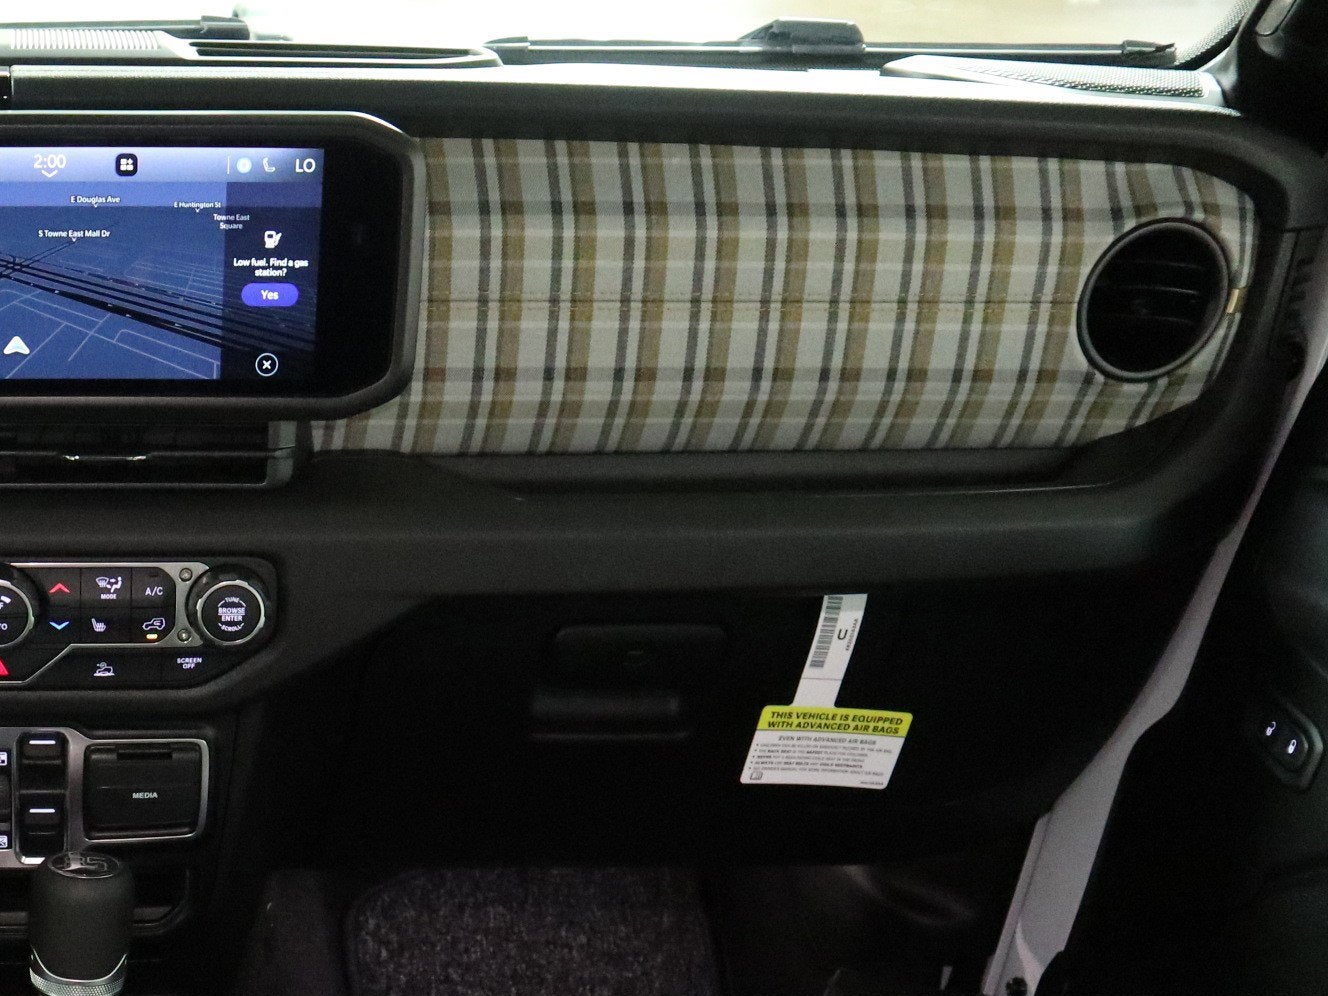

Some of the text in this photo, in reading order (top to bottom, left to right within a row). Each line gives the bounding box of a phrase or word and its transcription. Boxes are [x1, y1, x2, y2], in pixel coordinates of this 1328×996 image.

[33, 154, 66, 169] 2:00
[295, 158, 315, 173] LO
[76, 195, 105, 205] Douglas
[179, 201, 211, 210] Huntington
[219, 222, 243, 231] Square
[44, 230, 67, 238] Towne
[69, 230, 83, 238] East
[85, 230, 100, 238] Mall
[102, 230, 110, 238] Dr
[233, 258, 250, 267] Low
[251, 258, 268, 267] fuel.
[269, 258, 287, 267] Find
[294, 260, 309, 268] gas
[255, 268, 287, 277] station?
[261, 290, 279, 300] Yes
[145, 586, 163, 596] A/C
[771, 711, 793, 719] THIS
[796, 712, 837, 721] VEHICLE
[852, 714, 903, 726] EQUIPPED
[768, 720, 900, 735] WITH ADVANCED AIR BAGS
